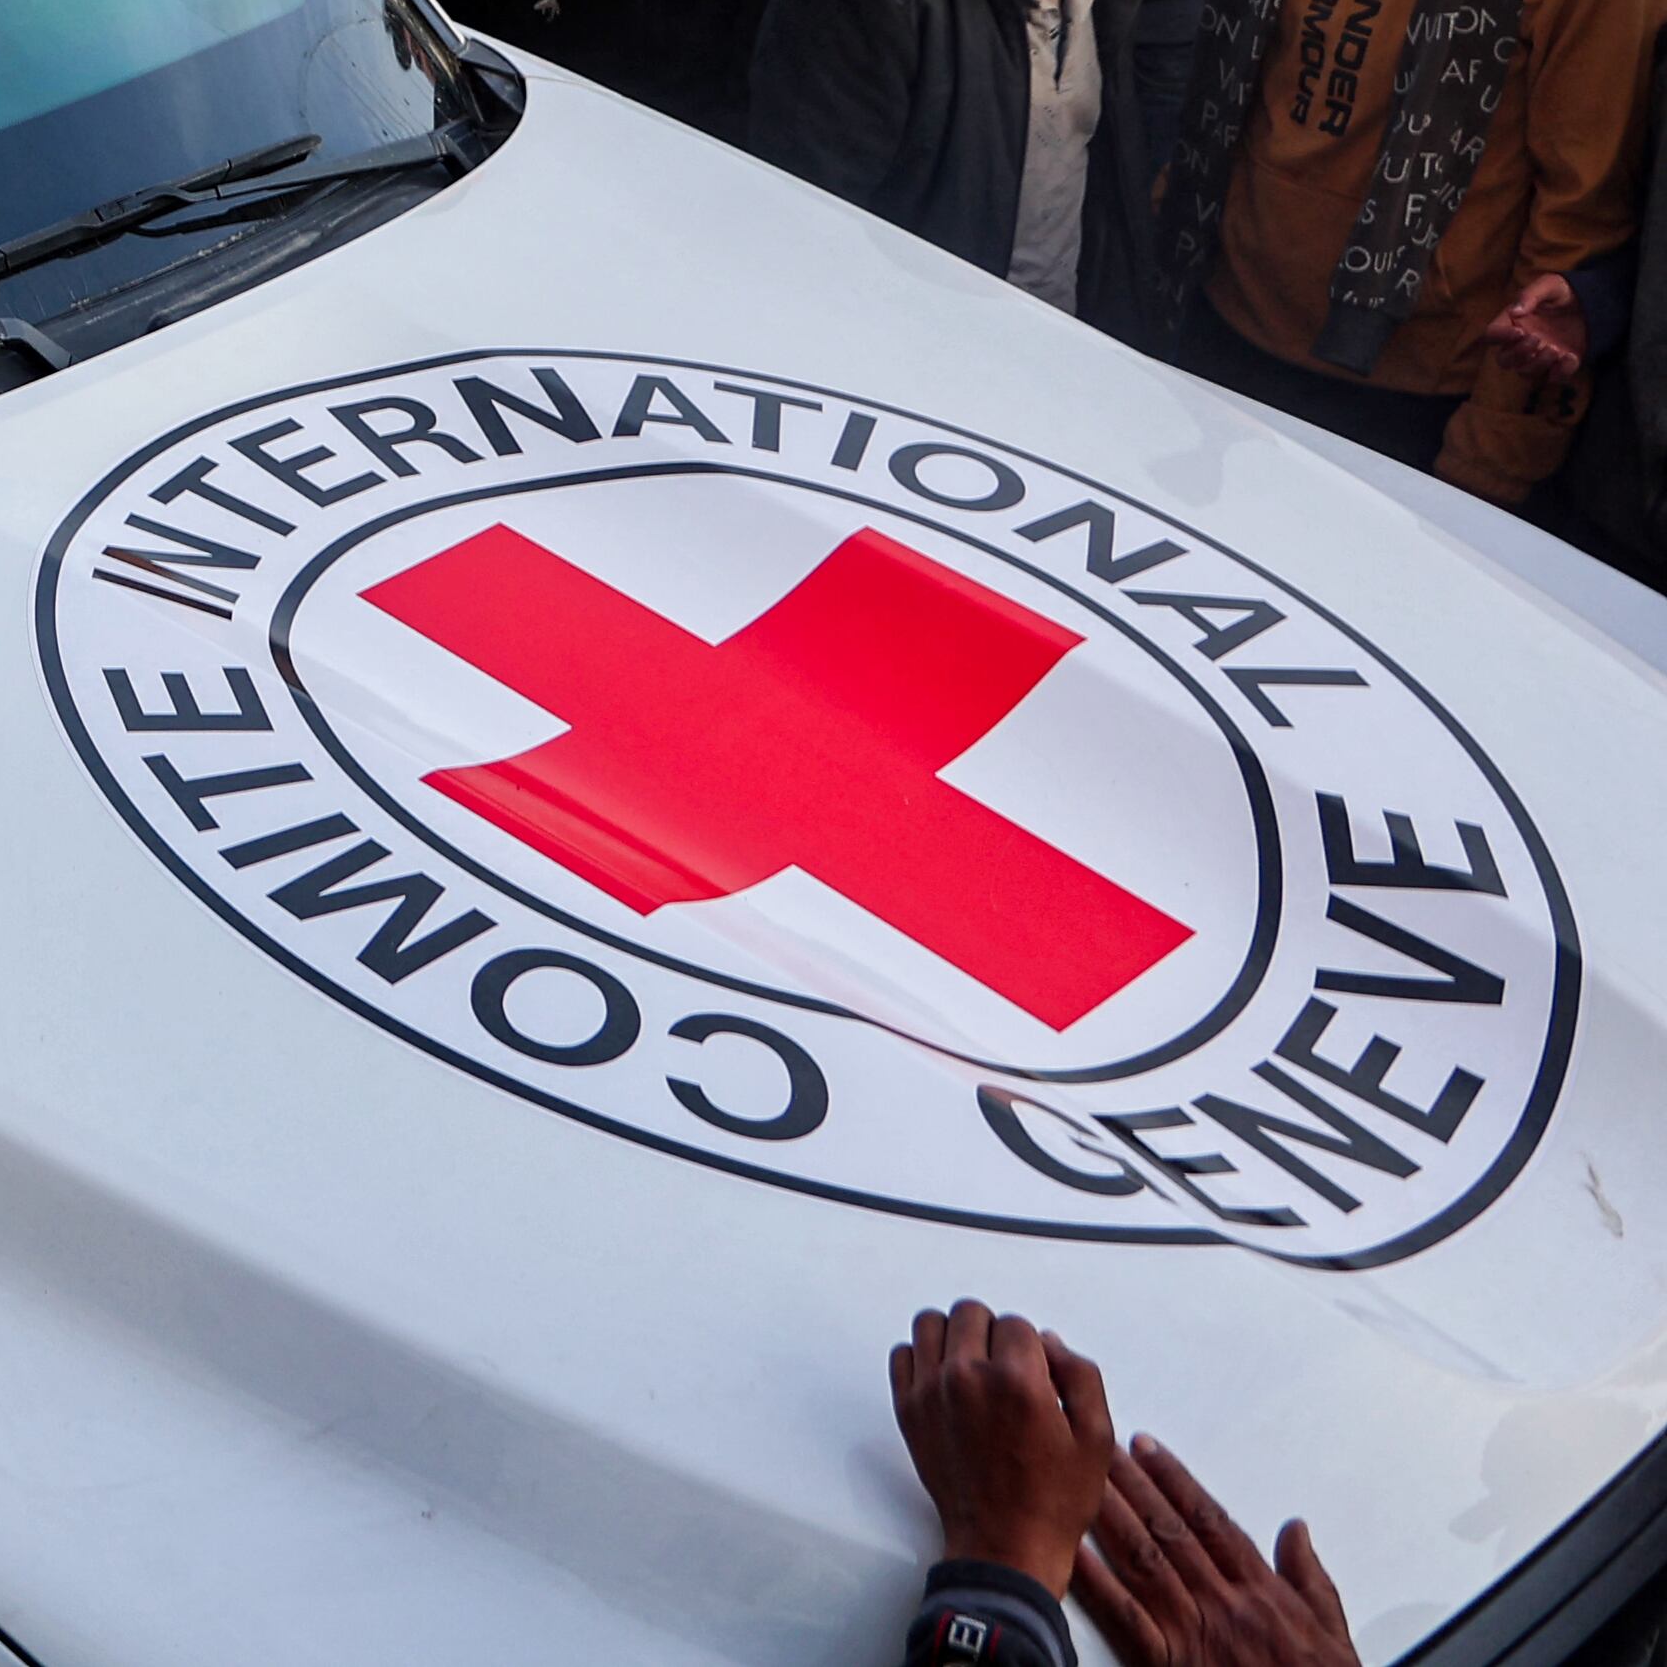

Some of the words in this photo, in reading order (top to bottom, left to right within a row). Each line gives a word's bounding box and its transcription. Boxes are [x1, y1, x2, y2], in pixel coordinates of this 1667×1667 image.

[91, 367, 1370, 729] INTERNATIONAL
[101, 666, 830, 1142] COMITE
[976, 790, 1510, 1229] GENEVE
